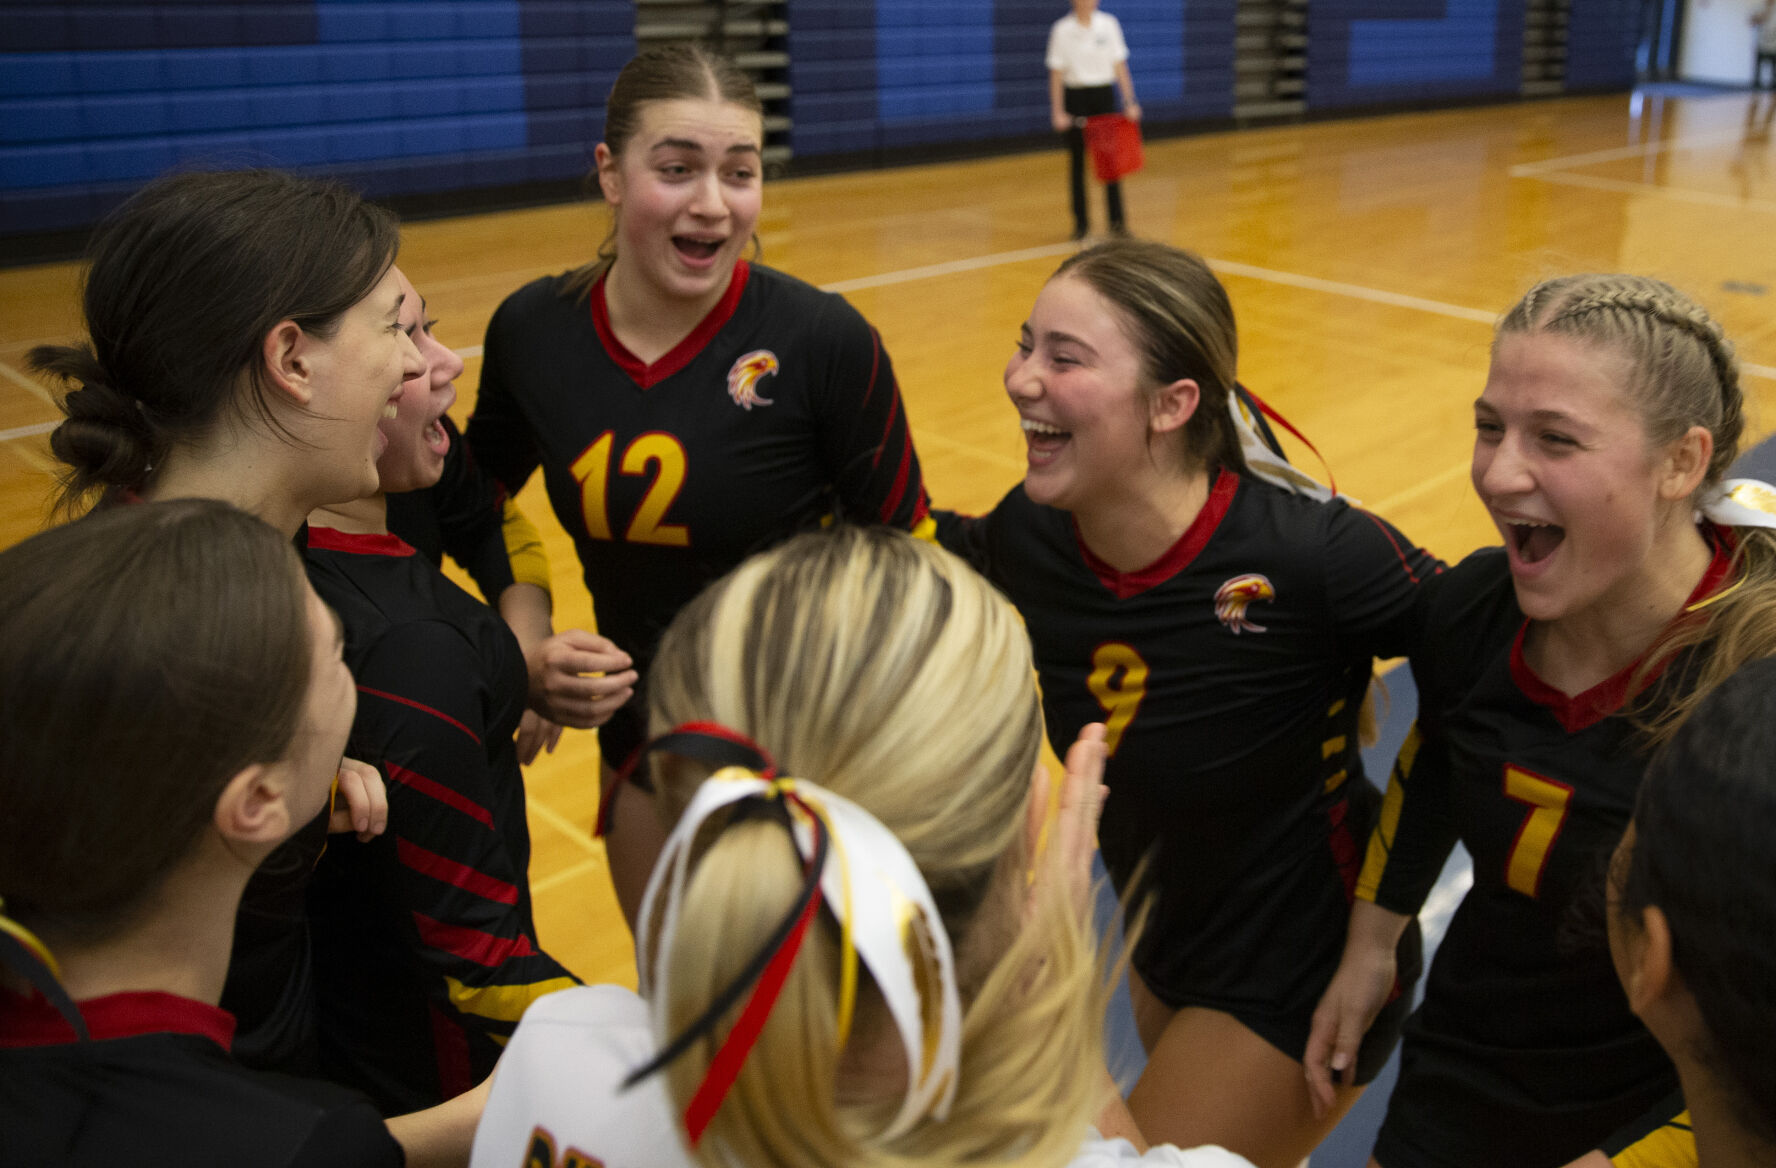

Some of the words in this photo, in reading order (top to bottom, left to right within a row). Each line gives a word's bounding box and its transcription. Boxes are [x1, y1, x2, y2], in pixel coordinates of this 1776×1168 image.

[567, 429, 691, 547] 12
[1085, 641, 1150, 759] 9
[1503, 761, 1575, 900] 7
